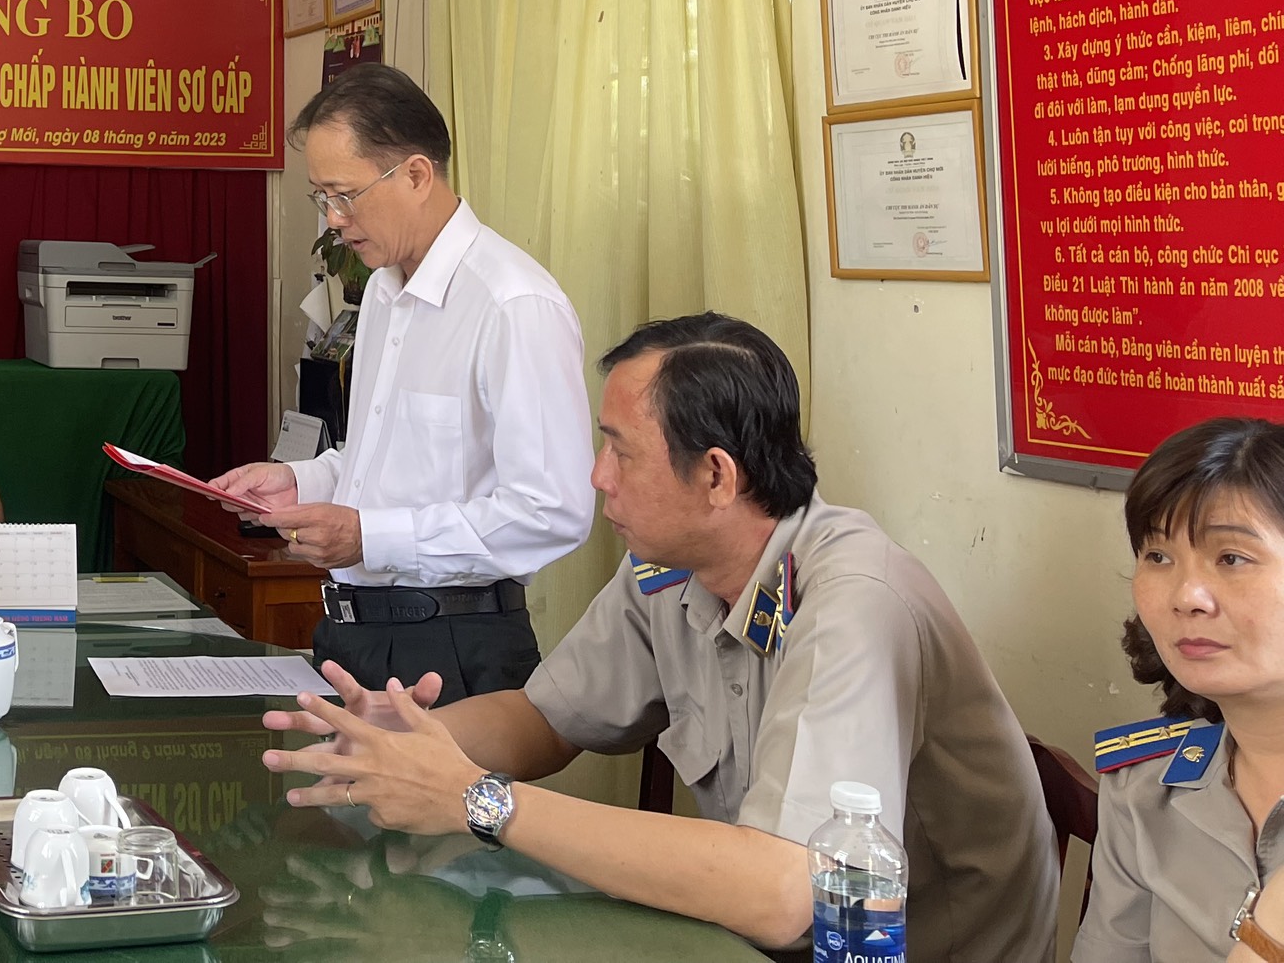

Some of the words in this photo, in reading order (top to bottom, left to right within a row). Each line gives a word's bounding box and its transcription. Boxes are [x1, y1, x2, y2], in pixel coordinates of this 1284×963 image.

[1029, 15, 1057, 35] lệnh,
[1058, 11, 1086, 30] hách
[1088, 7, 1117, 27] dịch,
[1119, 0, 1149, 21] hành
[0, 55, 55, 108] CHẤP
[63, 57, 118, 110] HÀNH
[126, 60, 171, 111] VIÊN
[179, 67, 205, 112] SƠ
[212, 54, 252, 114] CẤP
[1034, 102, 1045, 119] đi
[1047, 100, 1065, 118] đôi
[1067, 98, 1085, 116] với
[1086, 97, 1111, 114] làm,
[1113, 95, 1136, 114] lạm
[1138, 92, 1170, 112] dụng
[1172, 84, 1211, 111] quyền
[1213, 84, 1237, 106] lực.
[10, 127, 39, 144] Mới,
[44, 129, 80, 146] ngày
[83, 129, 100, 144] 08
[104, 130, 144, 148] tháng
[148, 131, 156, 145] 9
[159, 131, 189, 146] năm
[194, 133, 226, 146] 2023
[1037, 159, 1057, 176] lười
[1059, 155, 1095, 178] biếng,
[1097, 155, 1120, 178] phô
[1121, 156, 1164, 175] trương,
[1166, 151, 1195, 170] hình
[1196, 148, 1229, 168] thức.
[1040, 220, 1054, 234] vụ
[1056, 217, 1071, 236] lợi
[1072, 216, 1098, 234] dưới
[1100, 216, 1122, 236] mọi
[1124, 215, 1151, 233] hình
[1153, 215, 1184, 233] thức.
[1043, 273, 1068, 292] Điều
[1072, 275, 1085, 293] 21
[1090, 276, 1116, 297] Luật
[1119, 276, 1139, 294] Thi
[1143, 277, 1174, 295] hành
[1179, 276, 1195, 296] án
[1200, 277, 1229, 297] năm
[1233, 278, 1265, 298] 2008
[1044, 304, 1079, 327] không
[1081, 305, 1109, 324] được
